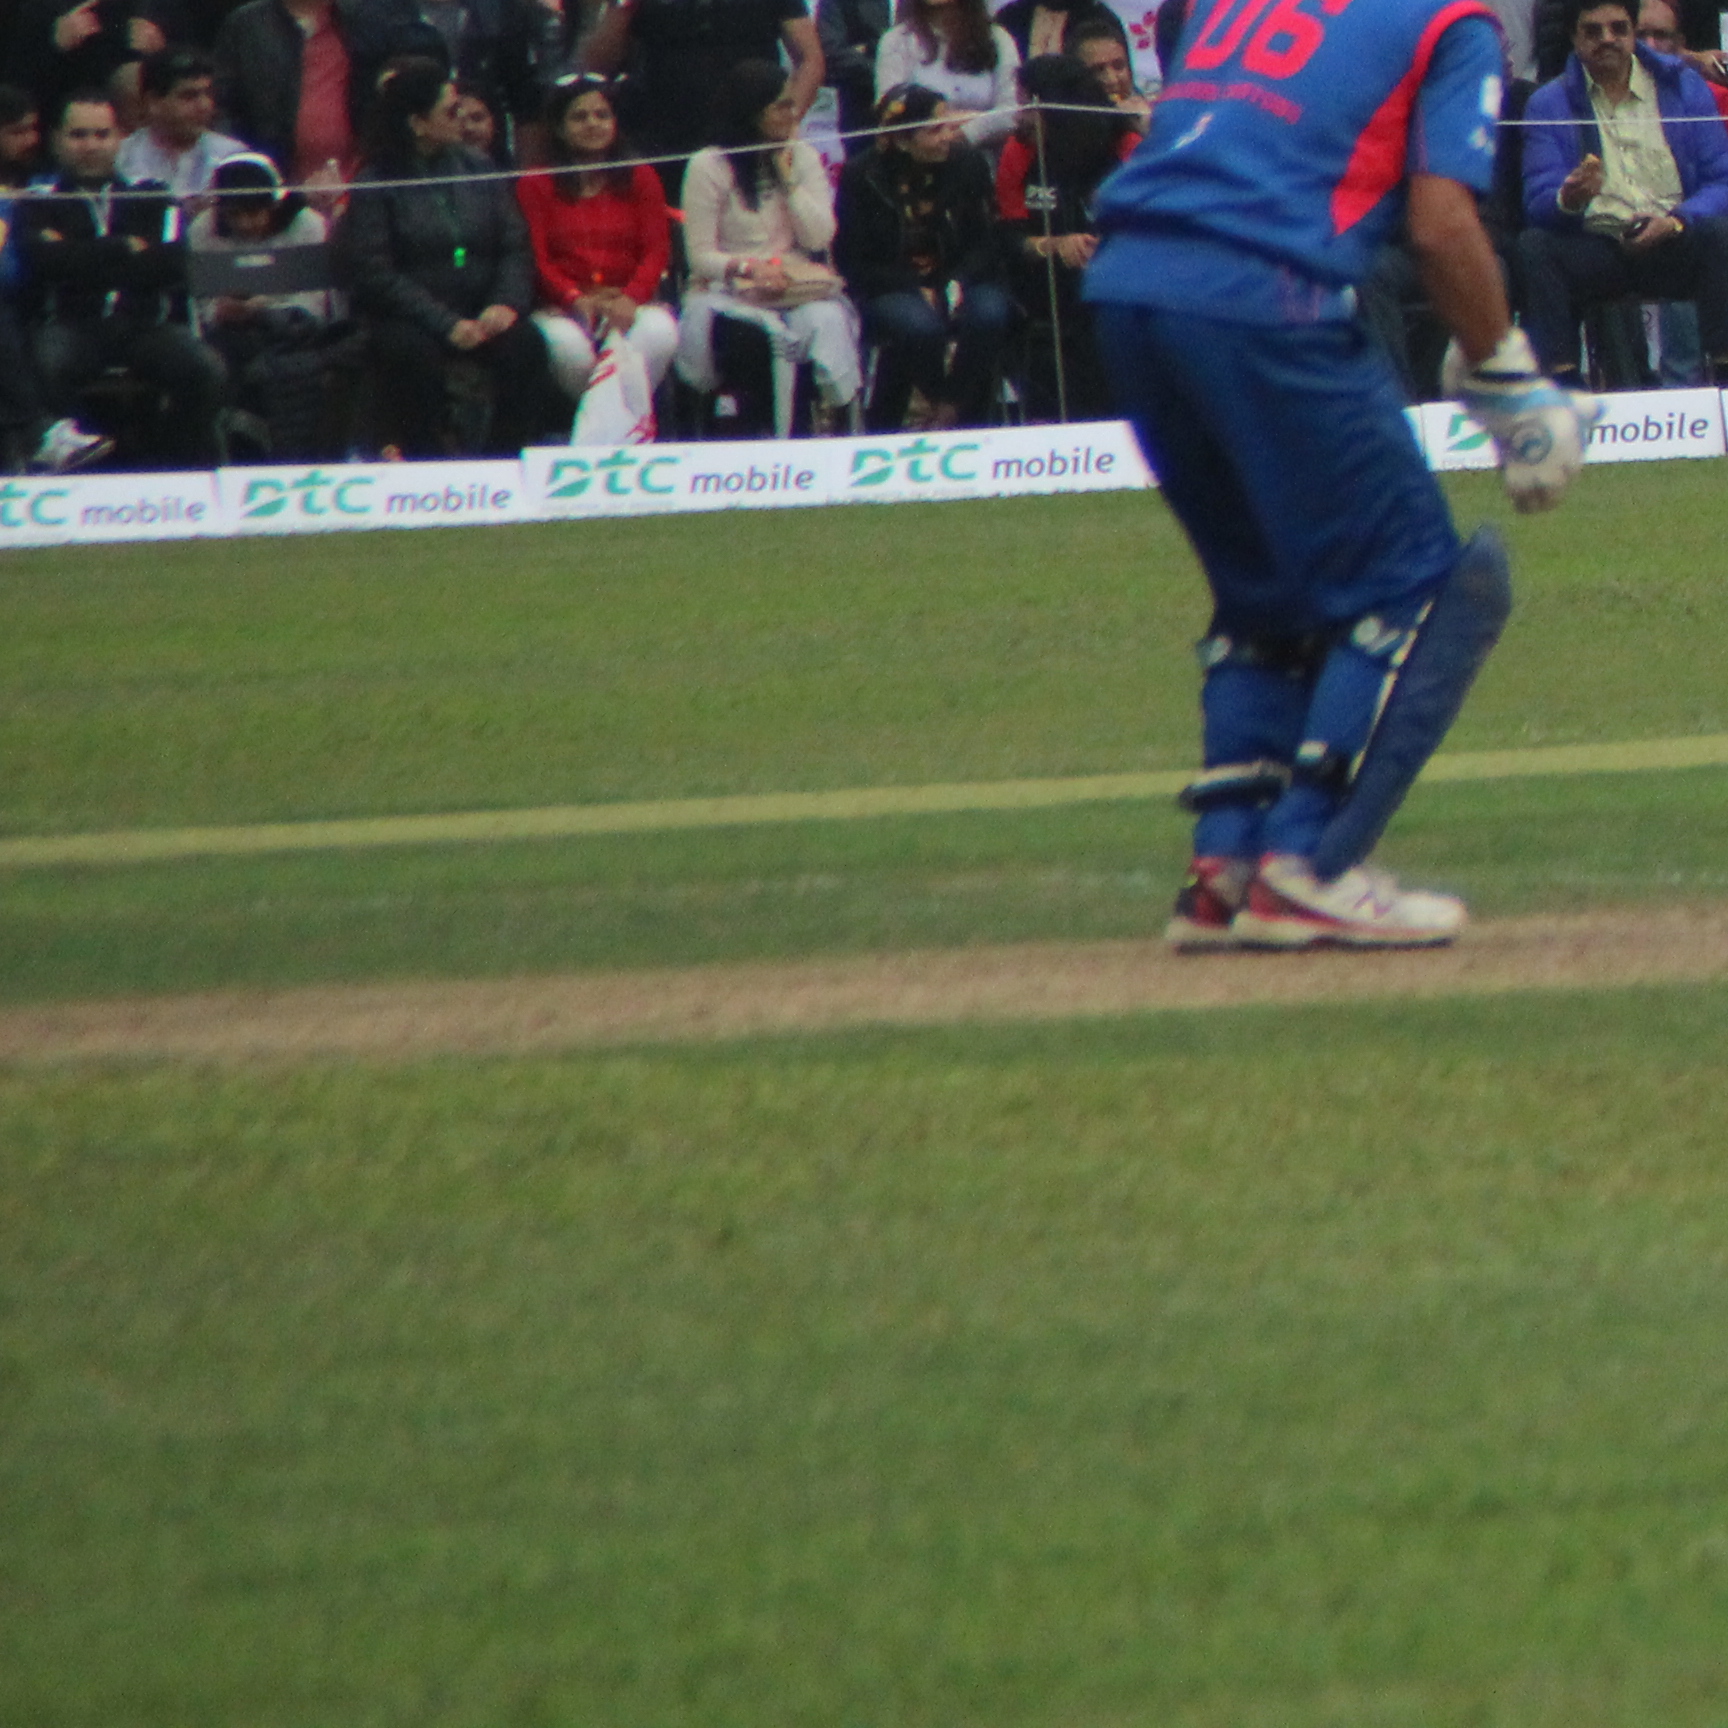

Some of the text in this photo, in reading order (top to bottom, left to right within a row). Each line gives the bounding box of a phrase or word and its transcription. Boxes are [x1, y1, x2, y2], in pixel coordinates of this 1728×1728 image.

[690, 464, 817, 496] mobile
[990, 448, 1117, 482] mobile
[81, 496, 207, 527] mobile
[384, 484, 513, 516] mobile
